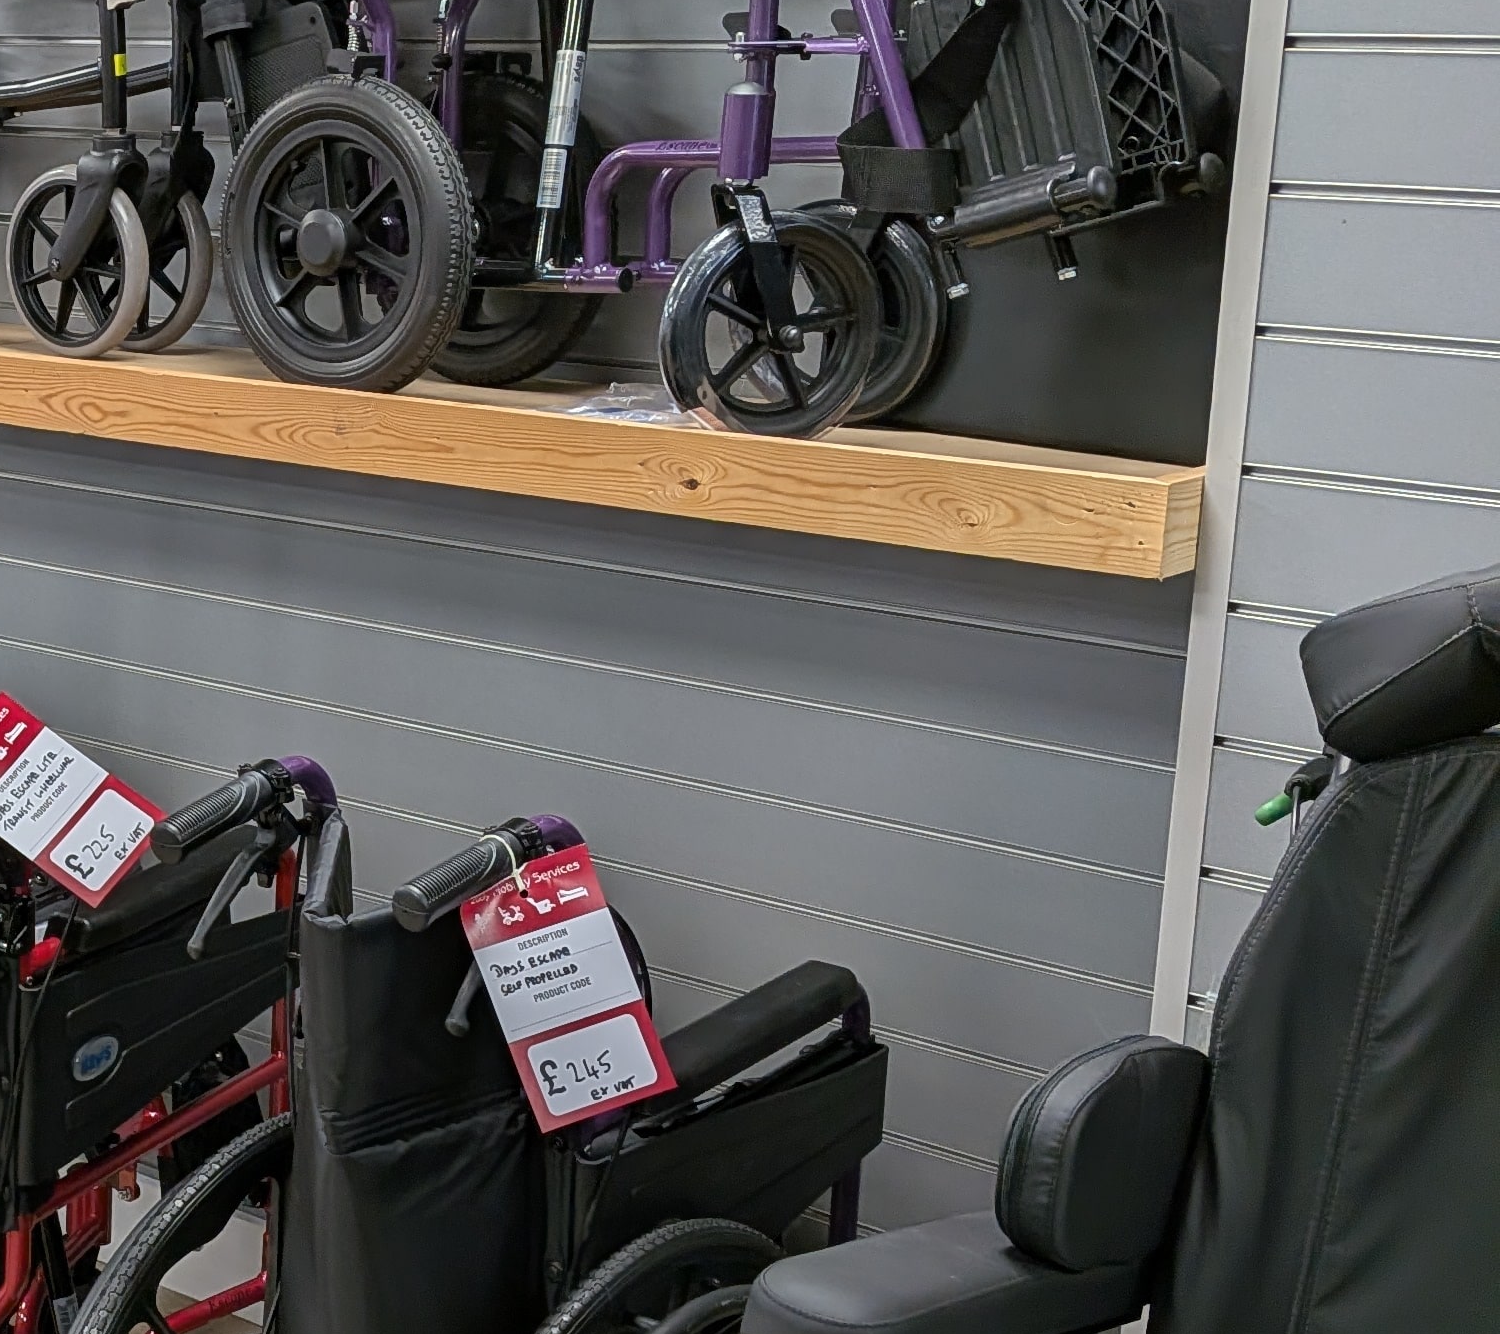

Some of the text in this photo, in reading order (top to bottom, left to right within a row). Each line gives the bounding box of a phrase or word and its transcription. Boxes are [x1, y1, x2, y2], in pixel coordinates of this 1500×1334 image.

[36, 750, 58, 773] LITE
[30, 781, 68, 822] PRODUCT CODE
[3, 798, 35, 832] TRANSIT
[64, 824, 115, 880] £ 225
[114, 822, 146, 861] EX VAT
[532, 860, 580, 884] Services
[517, 927, 569, 951] DESCRIPTION
[490, 960, 525, 979] DAYS
[501, 981, 522, 996] SELF
[533, 977, 592, 1003] PRODUCT CODE
[539, 1050, 612, 1096] £ 245
[614, 1075, 635, 1093] VAT
